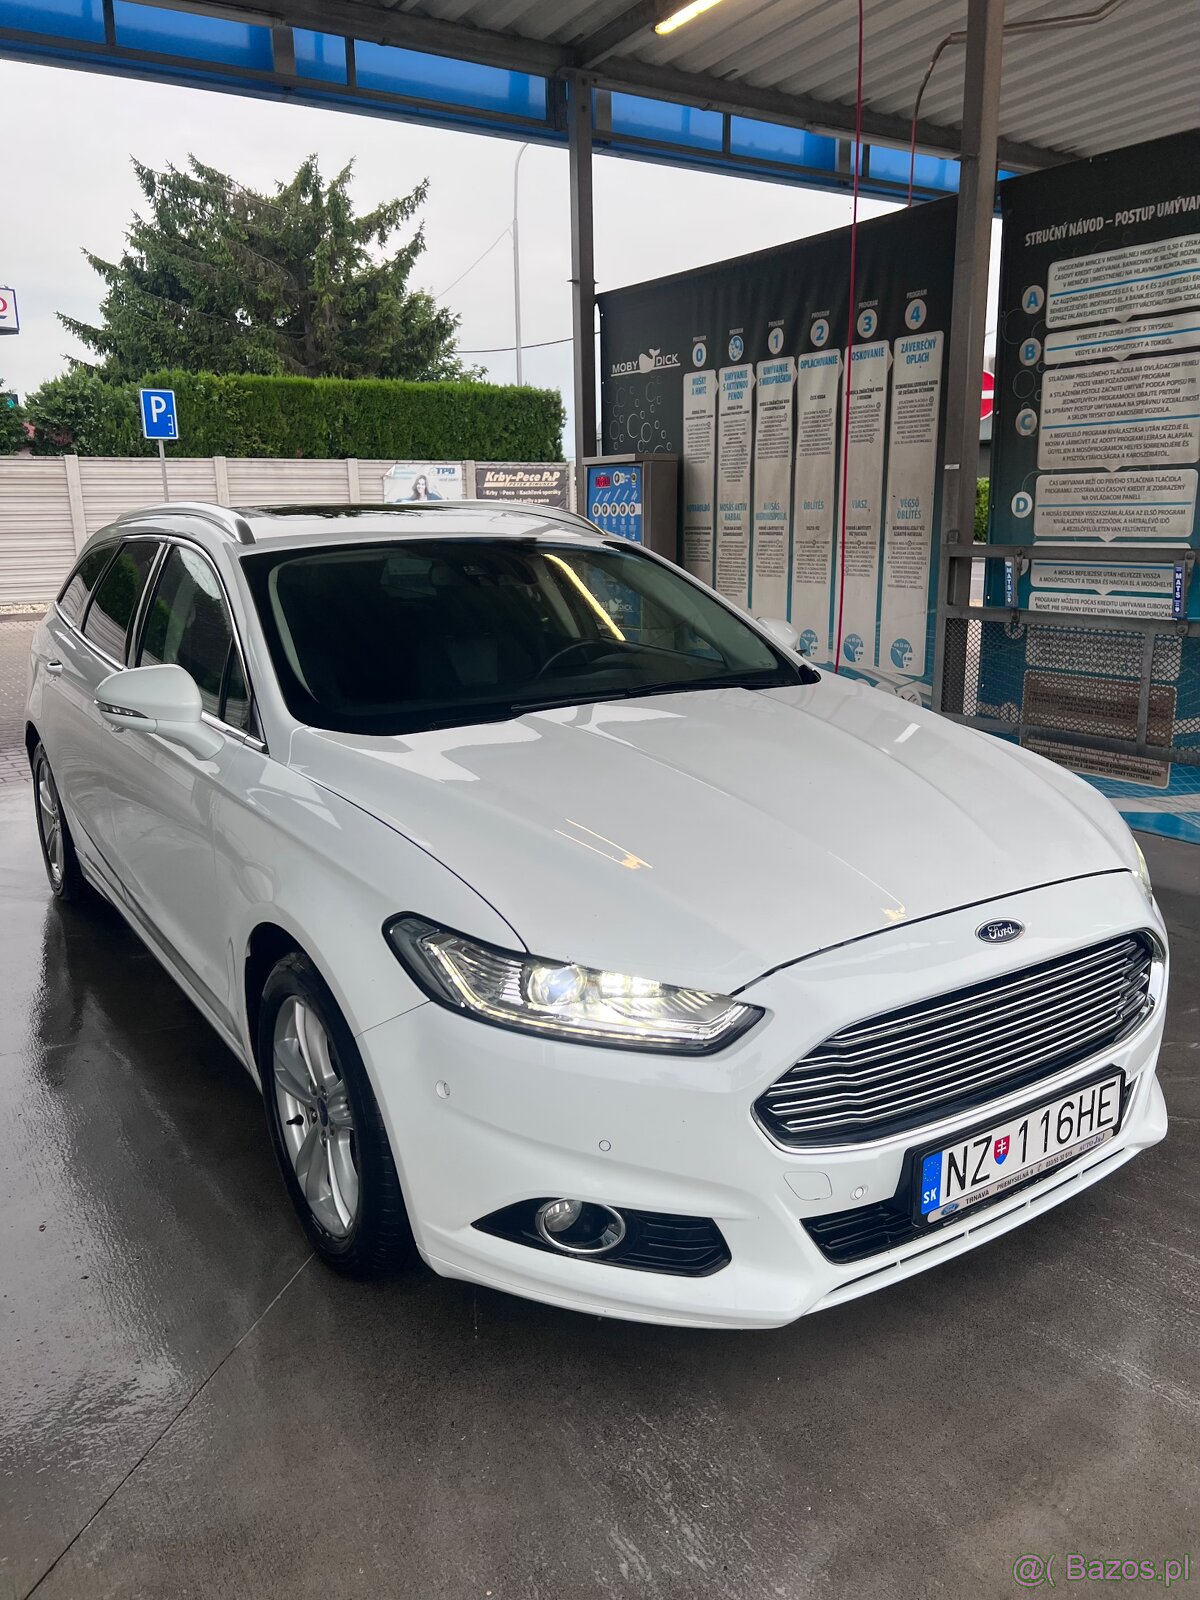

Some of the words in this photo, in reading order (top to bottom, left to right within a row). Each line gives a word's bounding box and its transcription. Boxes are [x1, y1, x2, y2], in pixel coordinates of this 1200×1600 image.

[1025, 221, 1068, 246] STRUČNÝ
[1068, 216, 1104, 237] NÁVOD
[1115, 205, 1155, 226] POSTUP
[906, 289, 927, 299] PROGRAM
[1026, 292, 1039, 308] A
[911, 306, 921, 322] 4
[863, 316, 872, 332] 3
[816, 325, 824, 341] 2
[773, 335, 778, 348] 1
[901, 336, 936, 353] ZÁVEREČNÝ
[696, 348, 703, 362] 0
[852, 347, 884, 360] OSKOVANIE
[906, 352, 929, 364] OPLACH
[1024, 344, 1036, 360] B
[612, 360, 638, 373] MOBY
[656, 353, 678, 366] DICK
[801, 355, 838, 369] OPLACHOVANIE
[150, 396, 166, 422] P
[1020, 414, 1032, 430] C
[485, 472, 541, 482] Krby-Pece
[900, 497, 919, 508] VÉGSŐ
[1016, 498, 1028, 513] D
[896, 508, 921, 520] ÖBLÍTÉS
[988, 922, 1014, 939] Ford
[946, 1135, 993, 1198] NZ
[1018, 1082, 1116, 1163] 116HE
[924, 1188, 937, 1204] SK
[966, 1190, 990, 1204] TRNAVA
